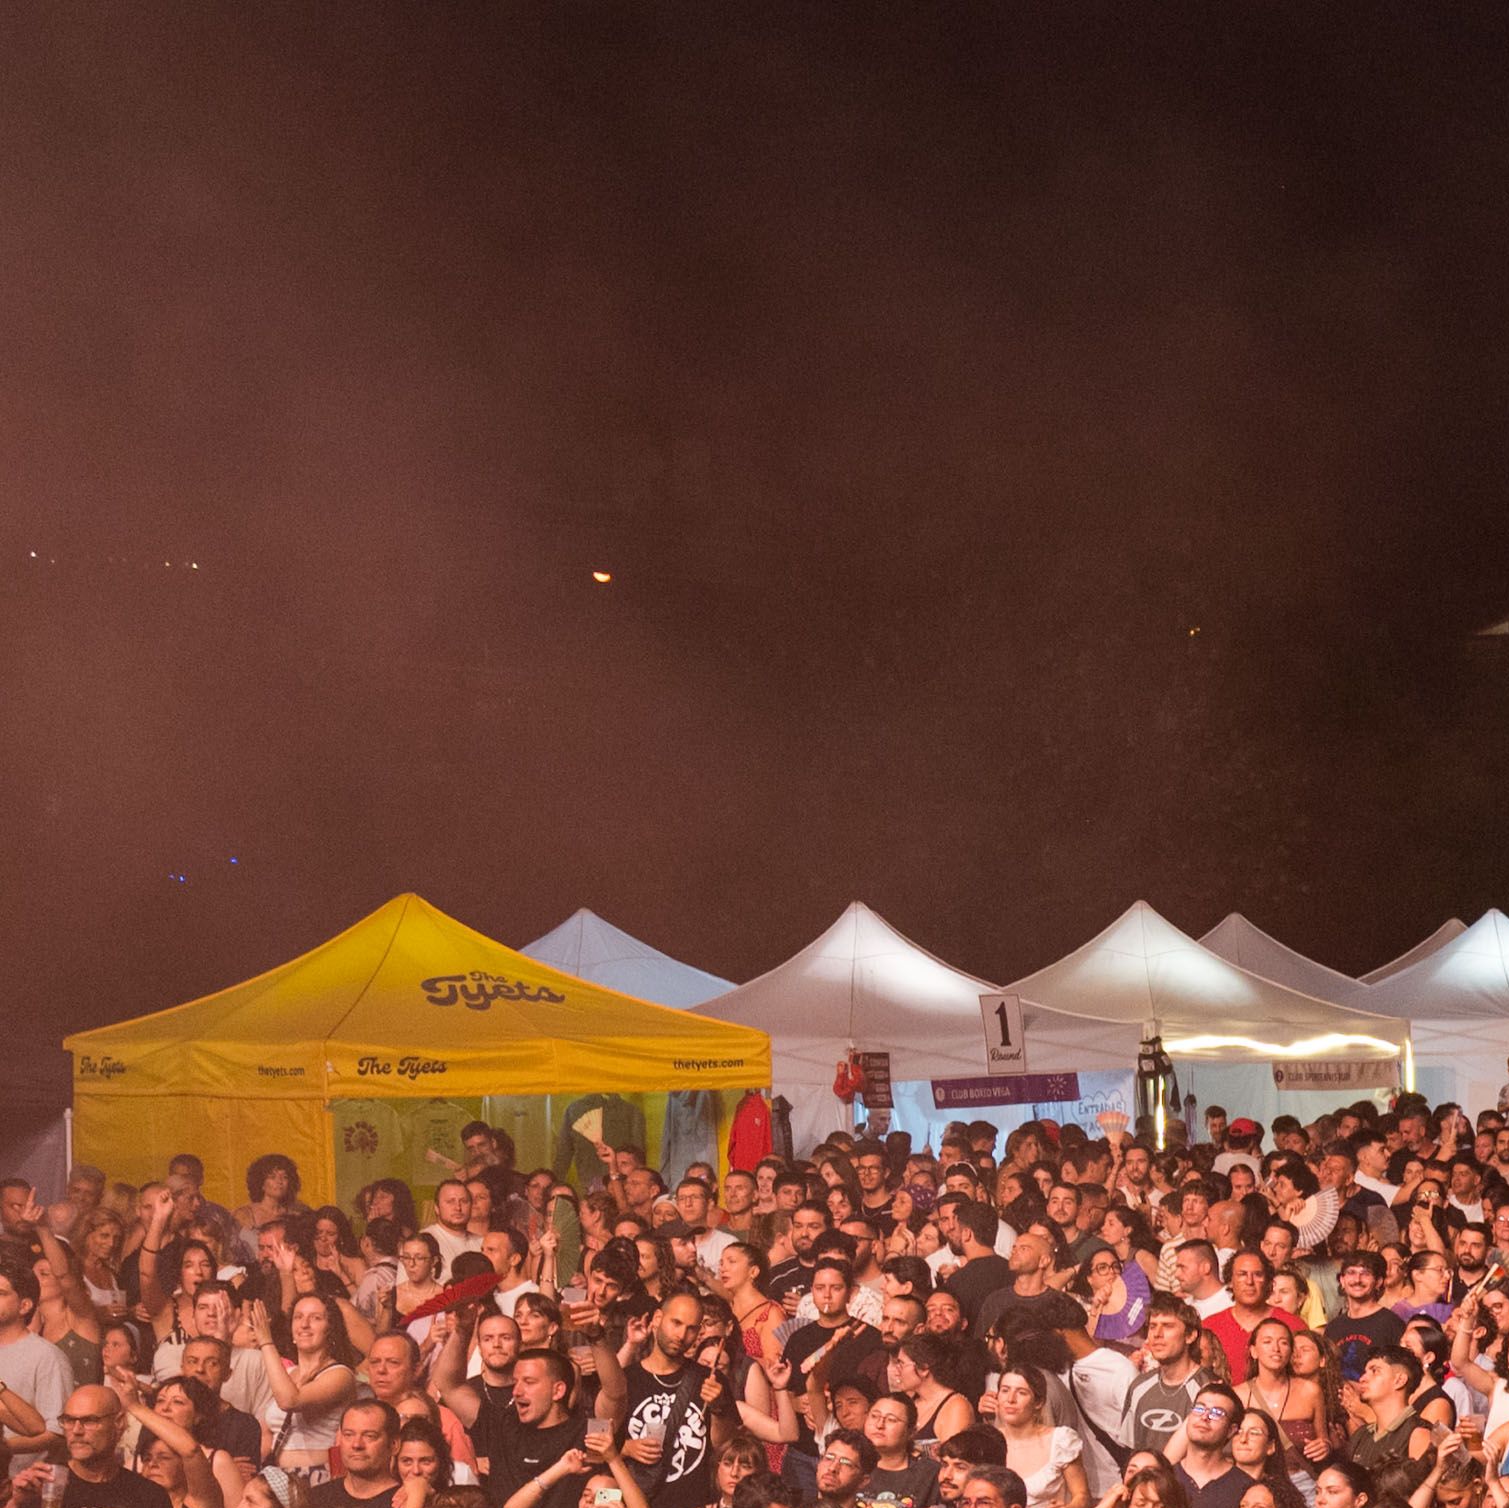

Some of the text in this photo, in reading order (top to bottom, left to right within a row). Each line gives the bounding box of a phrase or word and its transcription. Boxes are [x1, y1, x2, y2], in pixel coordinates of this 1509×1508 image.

[470, 970, 508, 984] The
[421, 974, 566, 1011] Tyets
[994, 1001, 1013, 1047] 1
[989, 1048, 1023, 1062] Round
[80, 1056, 97, 1075] The
[357, 1056, 448, 1080] The Tyets
[673, 1058, 745, 1072] thetyets.com
[258, 1066, 305, 1079] thetyets.com
[951, 1088, 968, 1100] CLUB
